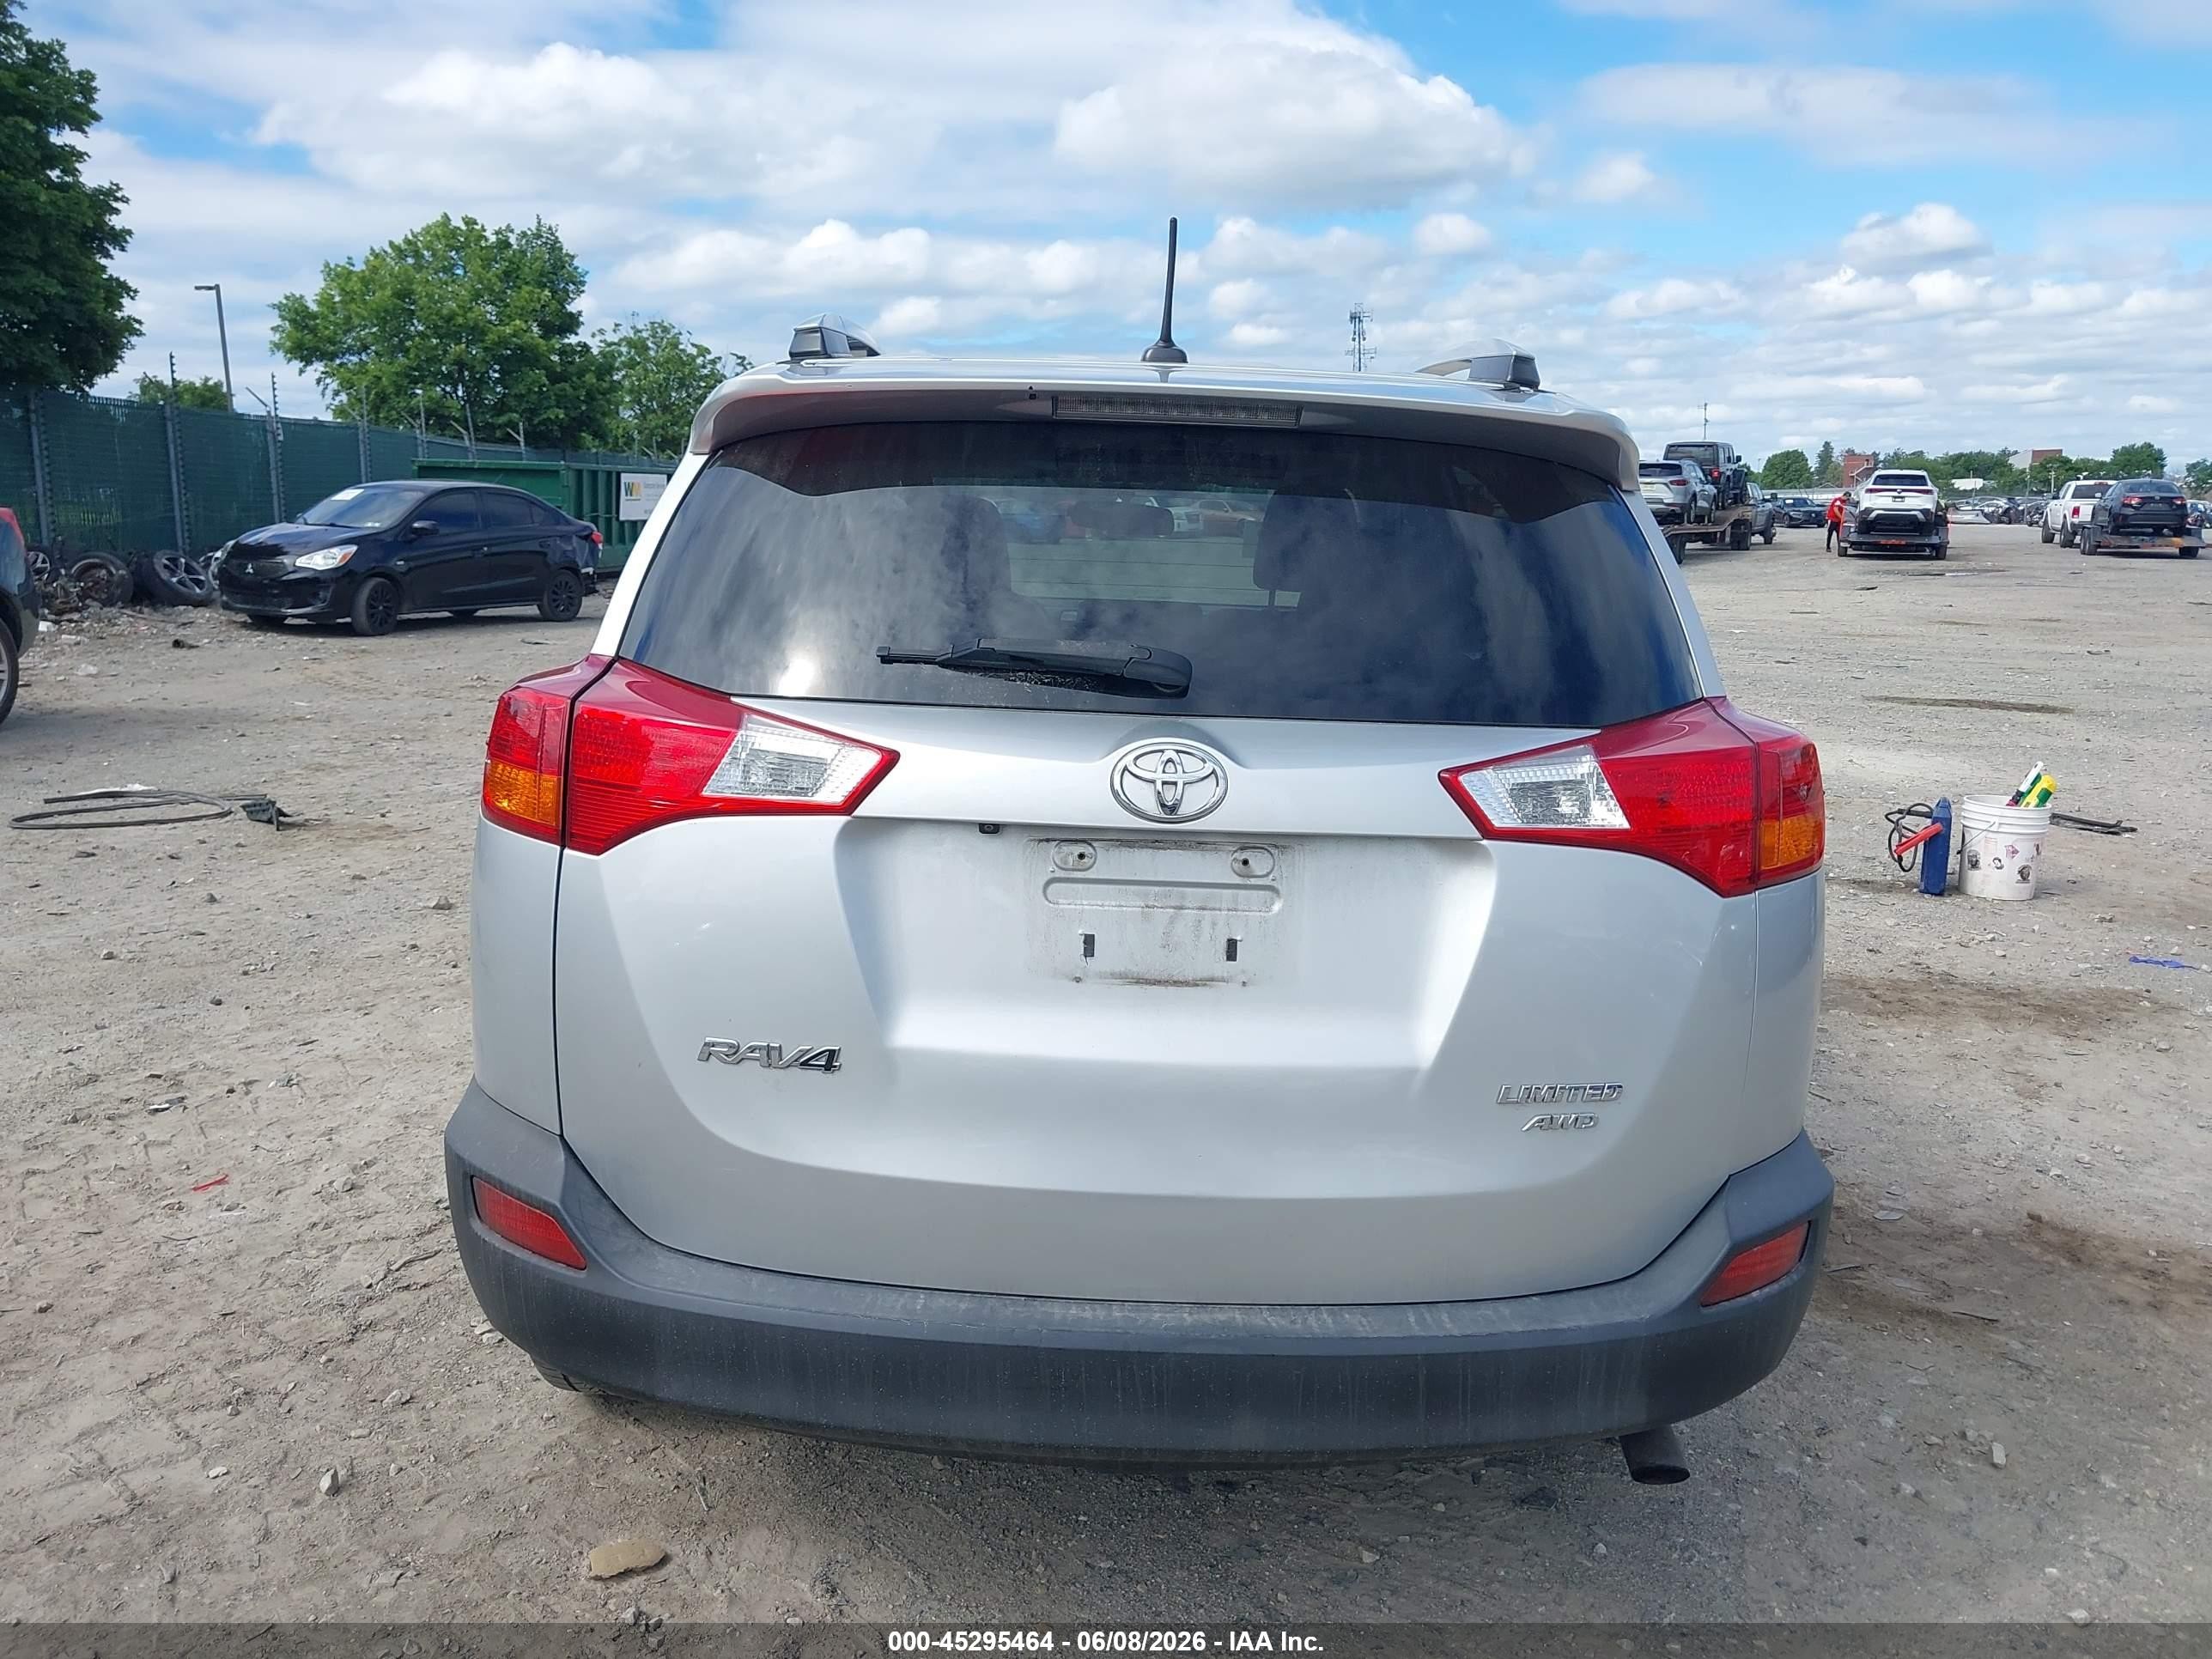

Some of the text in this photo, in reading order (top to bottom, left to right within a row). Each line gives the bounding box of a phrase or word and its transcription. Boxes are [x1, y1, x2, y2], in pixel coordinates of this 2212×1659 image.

[623, 481, 642, 496] WM
[697, 1036, 842, 1073] RAV4
[1497, 1082, 1623, 1104] LIMITED
[1521, 1112, 1599, 1132] AWD
